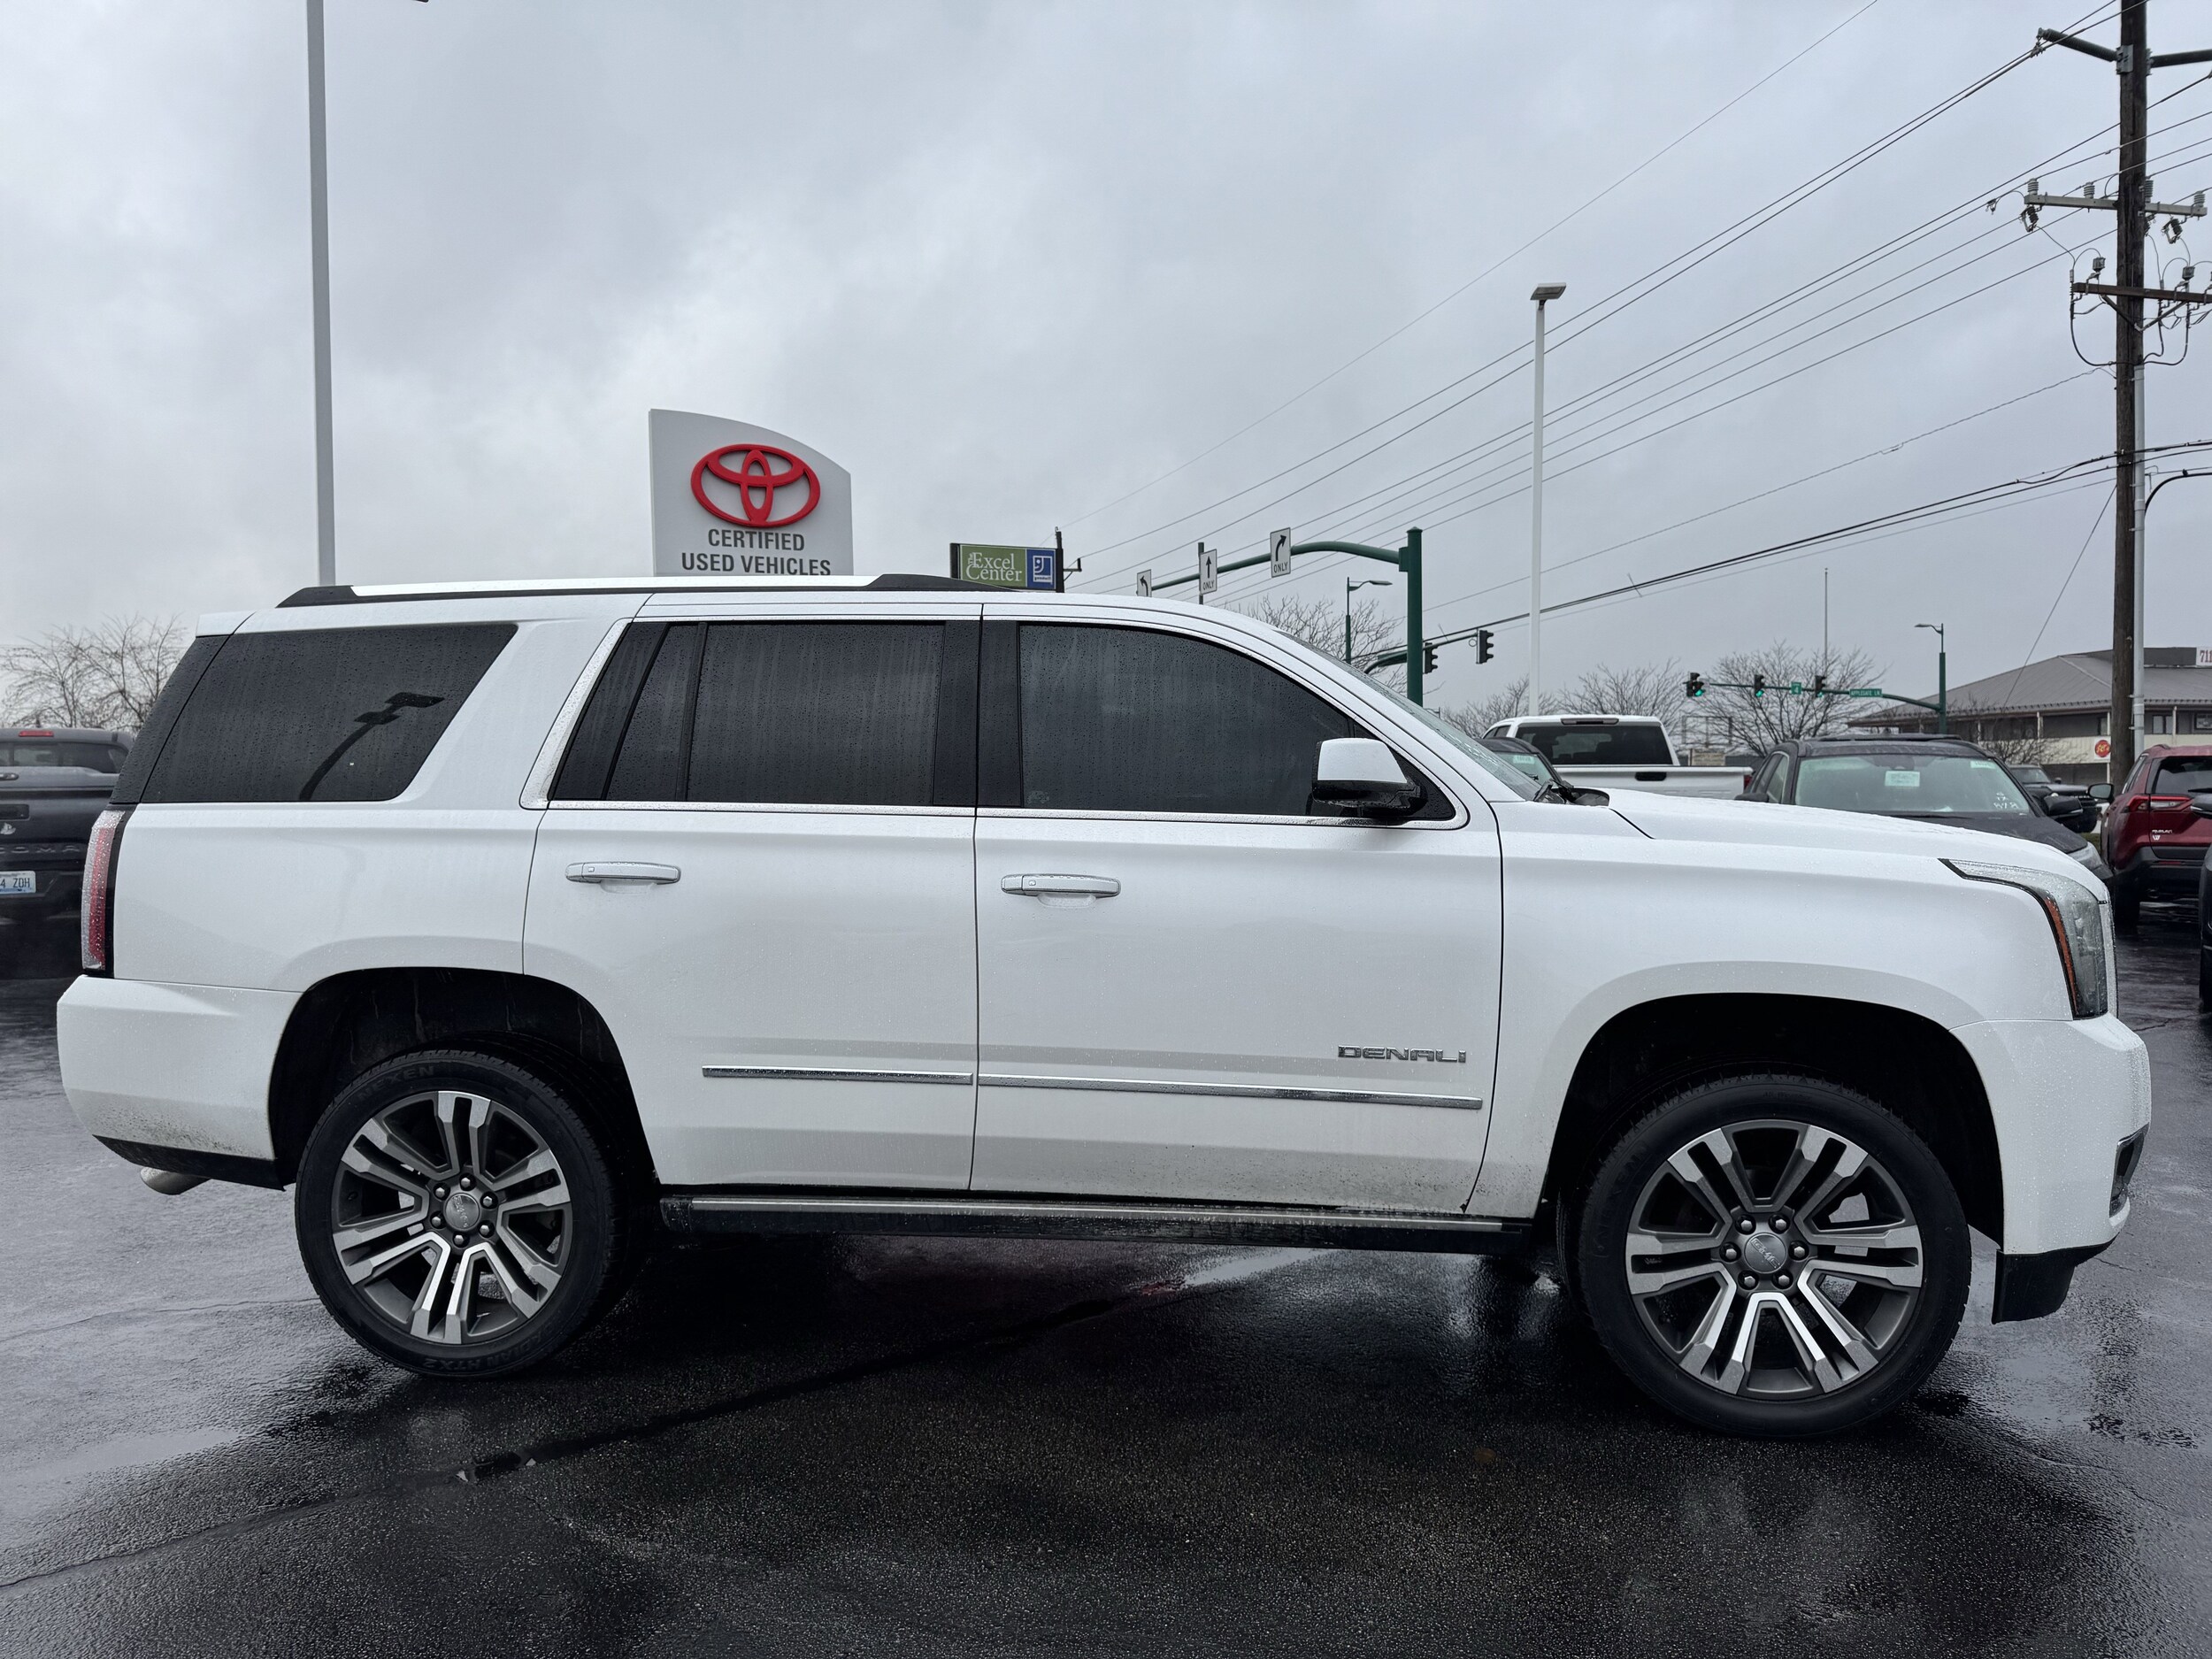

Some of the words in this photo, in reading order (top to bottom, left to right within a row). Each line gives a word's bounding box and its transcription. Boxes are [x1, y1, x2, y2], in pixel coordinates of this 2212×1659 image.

[708, 529, 804, 551] CERTIFIED
[681, 552, 734, 572] USED
[741, 556, 831, 576] VEHICLES
[972, 552, 1015, 571] Excel
[1274, 562, 1287, 573] ONLY
[966, 565, 1023, 581] Center
[1203, 580, 1215, 590] ONLY
[1338, 1044, 1466, 1064] DENALI
